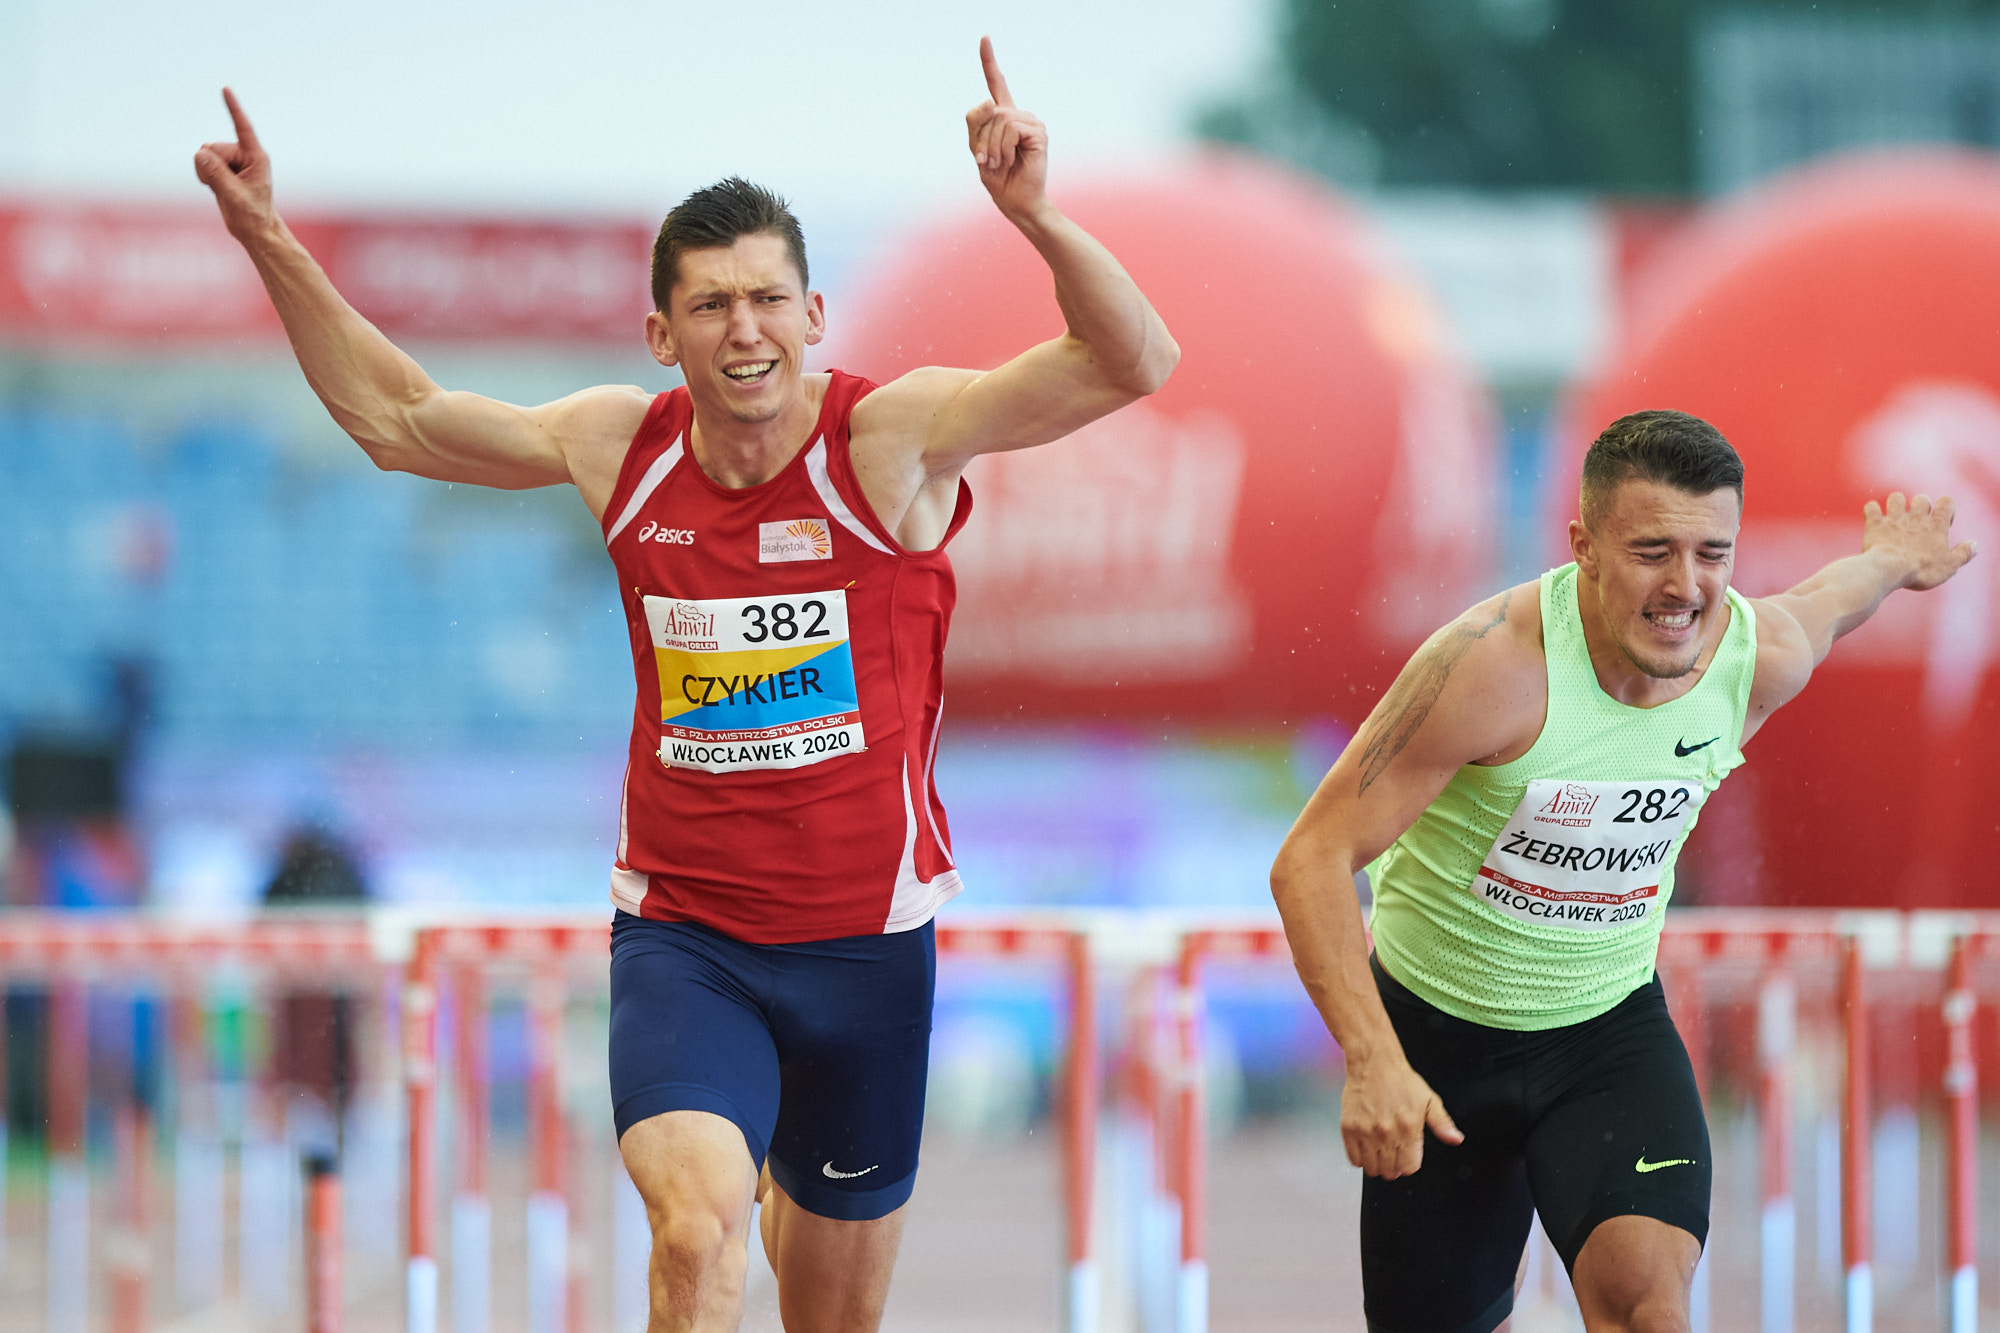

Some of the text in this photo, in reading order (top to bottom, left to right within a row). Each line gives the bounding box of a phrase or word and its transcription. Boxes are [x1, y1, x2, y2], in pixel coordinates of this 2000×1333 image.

[761, 541, 807, 555] Białystok
[664, 606, 714, 637] Anwil
[741, 600, 830, 643] 382
[665, 639, 717, 650] GRUPA ORLEN
[682, 667, 823, 707] CZYKIER
[690, 730, 714, 741] PZLA
[717, 724, 802, 741] MISTRZOSTWA
[803, 715, 846, 731] POLSKI
[672, 731, 850, 763] WŁOCŁAWEK 2020
[1539, 787, 1600, 816] Anwil
[1613, 788, 1689, 823] 282
[1534, 816, 1590, 827] GRUPA ORLEN
[1500, 830, 1671, 872] ŻEBROWSKI
[1486, 883, 1646, 922] WŁOCŁAWEK 2020
[1513, 881, 1542, 896] PZLA
[1544, 890, 1619, 903] MISTRZOSTWA
[1621, 889, 1649, 903] POLSKI
